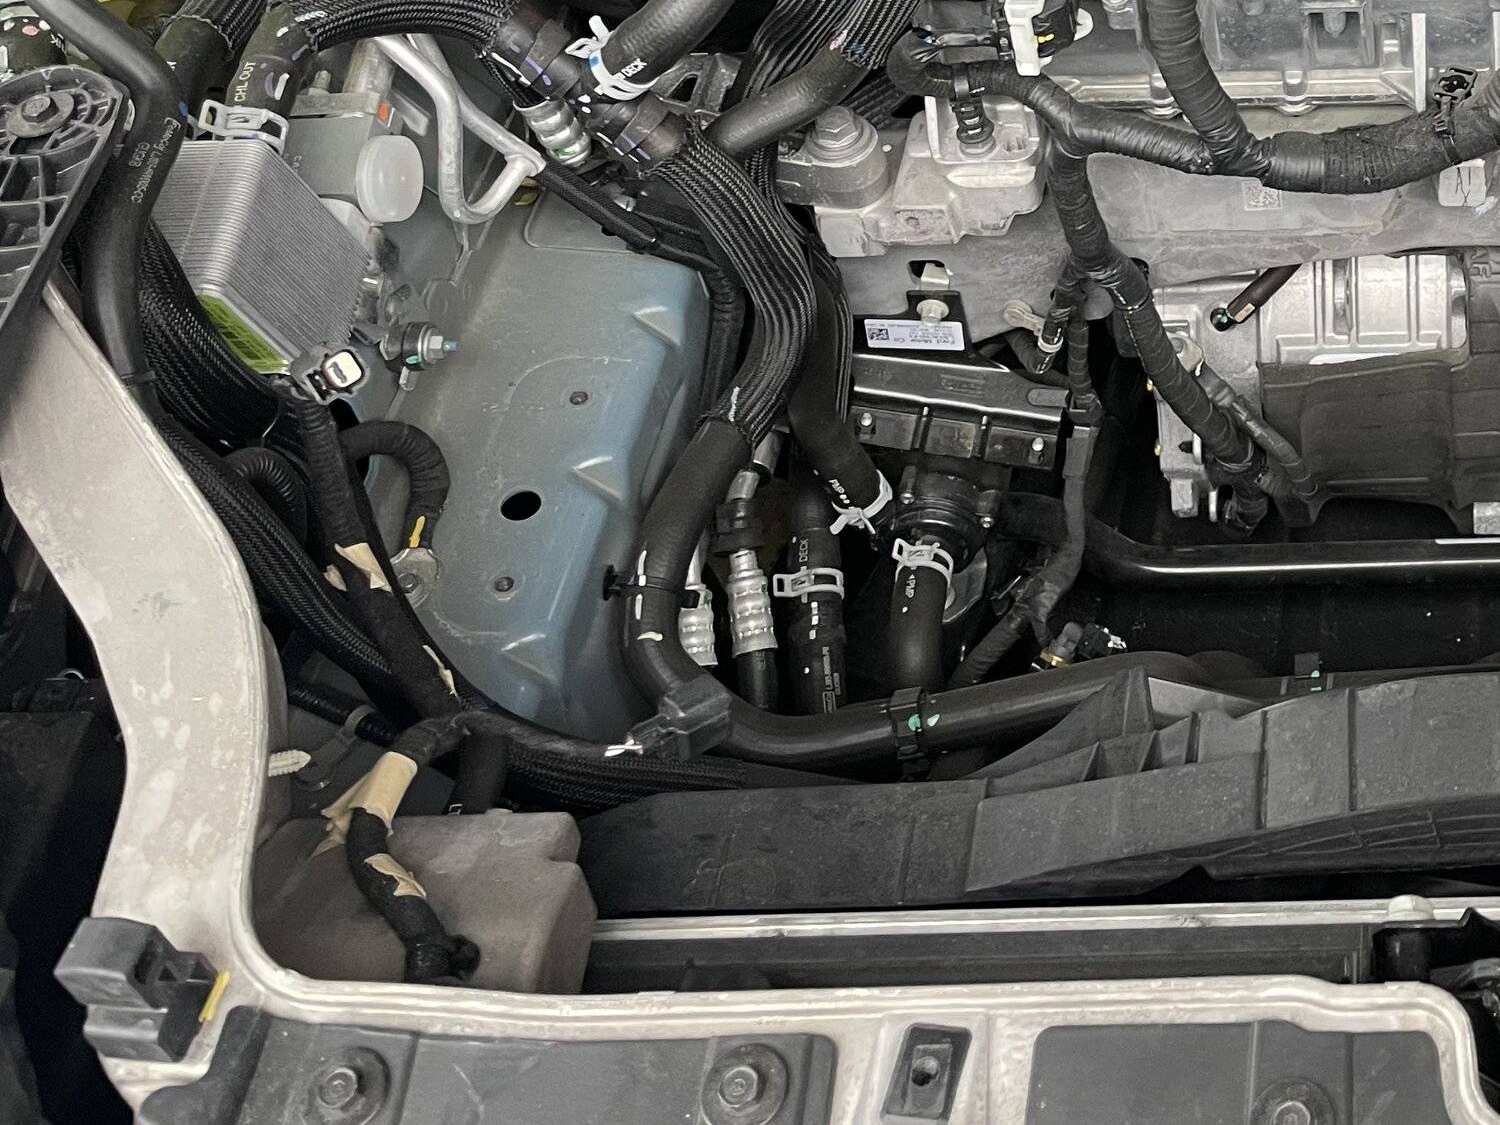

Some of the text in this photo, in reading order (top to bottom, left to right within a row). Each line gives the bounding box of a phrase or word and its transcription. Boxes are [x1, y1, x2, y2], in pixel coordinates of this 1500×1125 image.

[620, 58, 648, 77] DECK
[235, 61, 256, 101] CHL OUT
[799, 539, 809, 562] DECK
